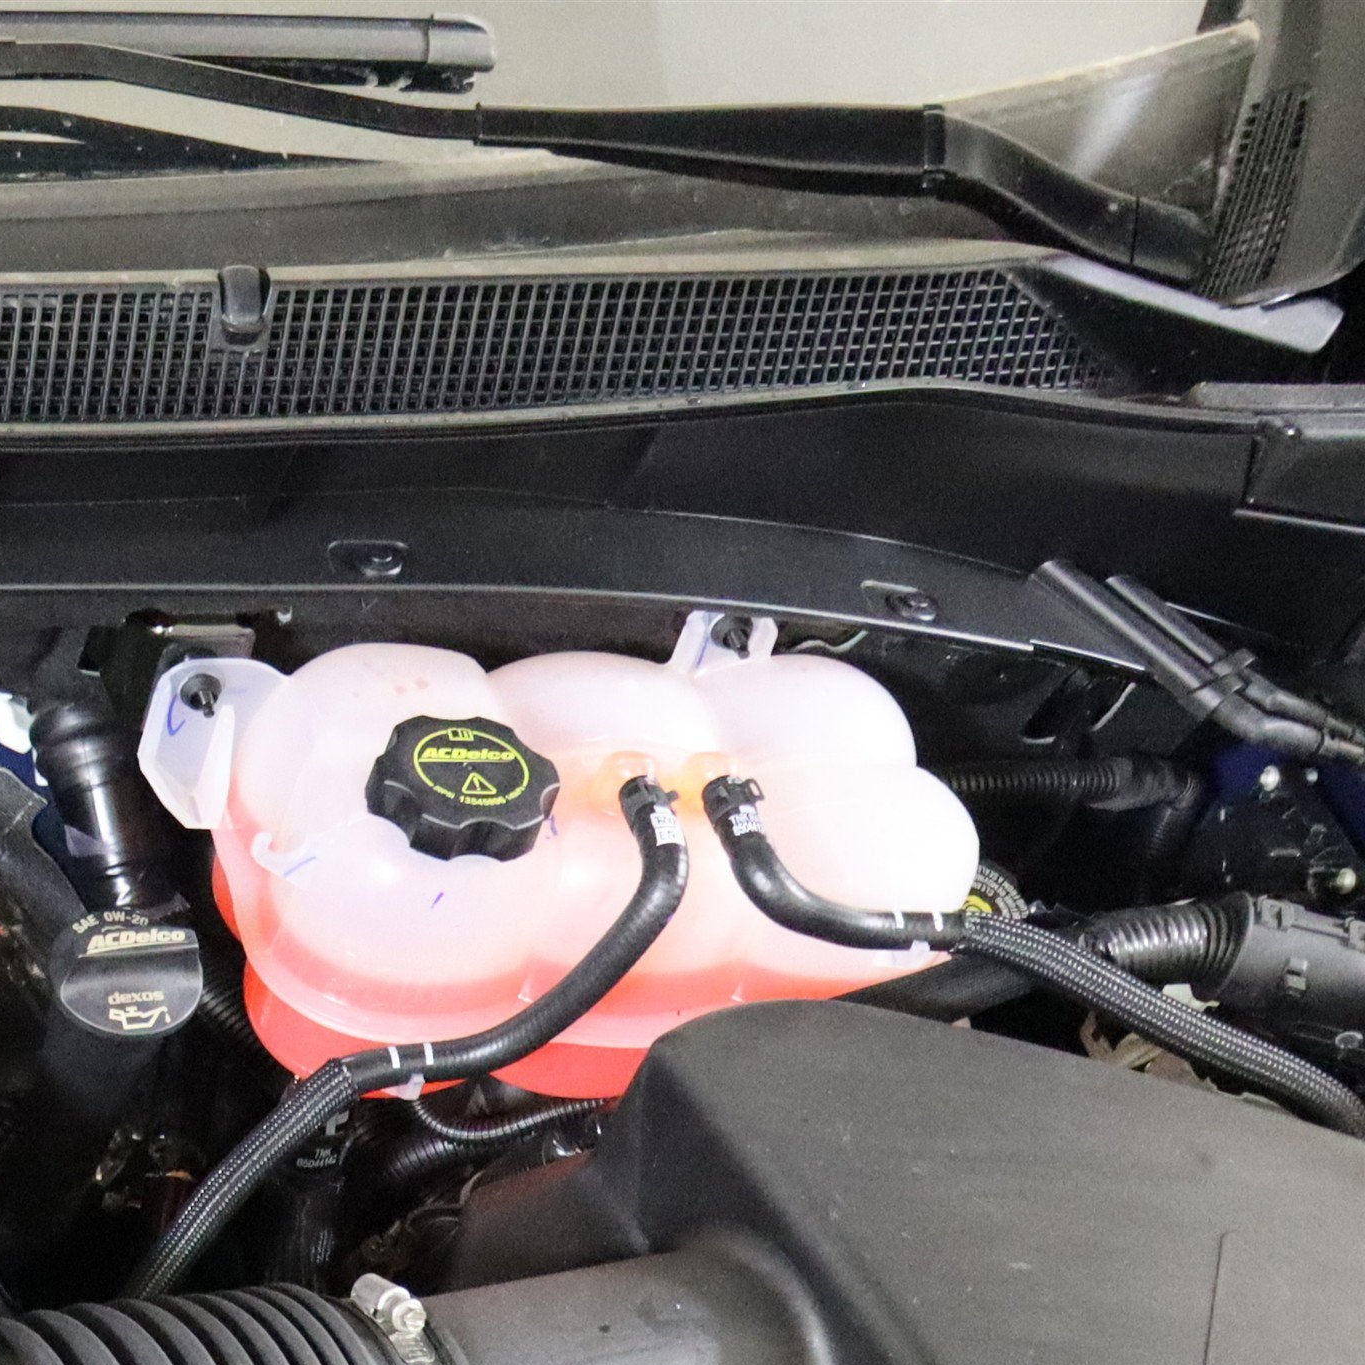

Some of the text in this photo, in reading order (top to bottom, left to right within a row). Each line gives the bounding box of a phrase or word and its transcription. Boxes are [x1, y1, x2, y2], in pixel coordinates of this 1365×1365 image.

[419, 747, 515, 761] ACDelco
[72, 911, 149, 934] SAE 0W-20
[88, 929, 186, 950] ACDelco
[107, 991, 165, 1005] dexos
